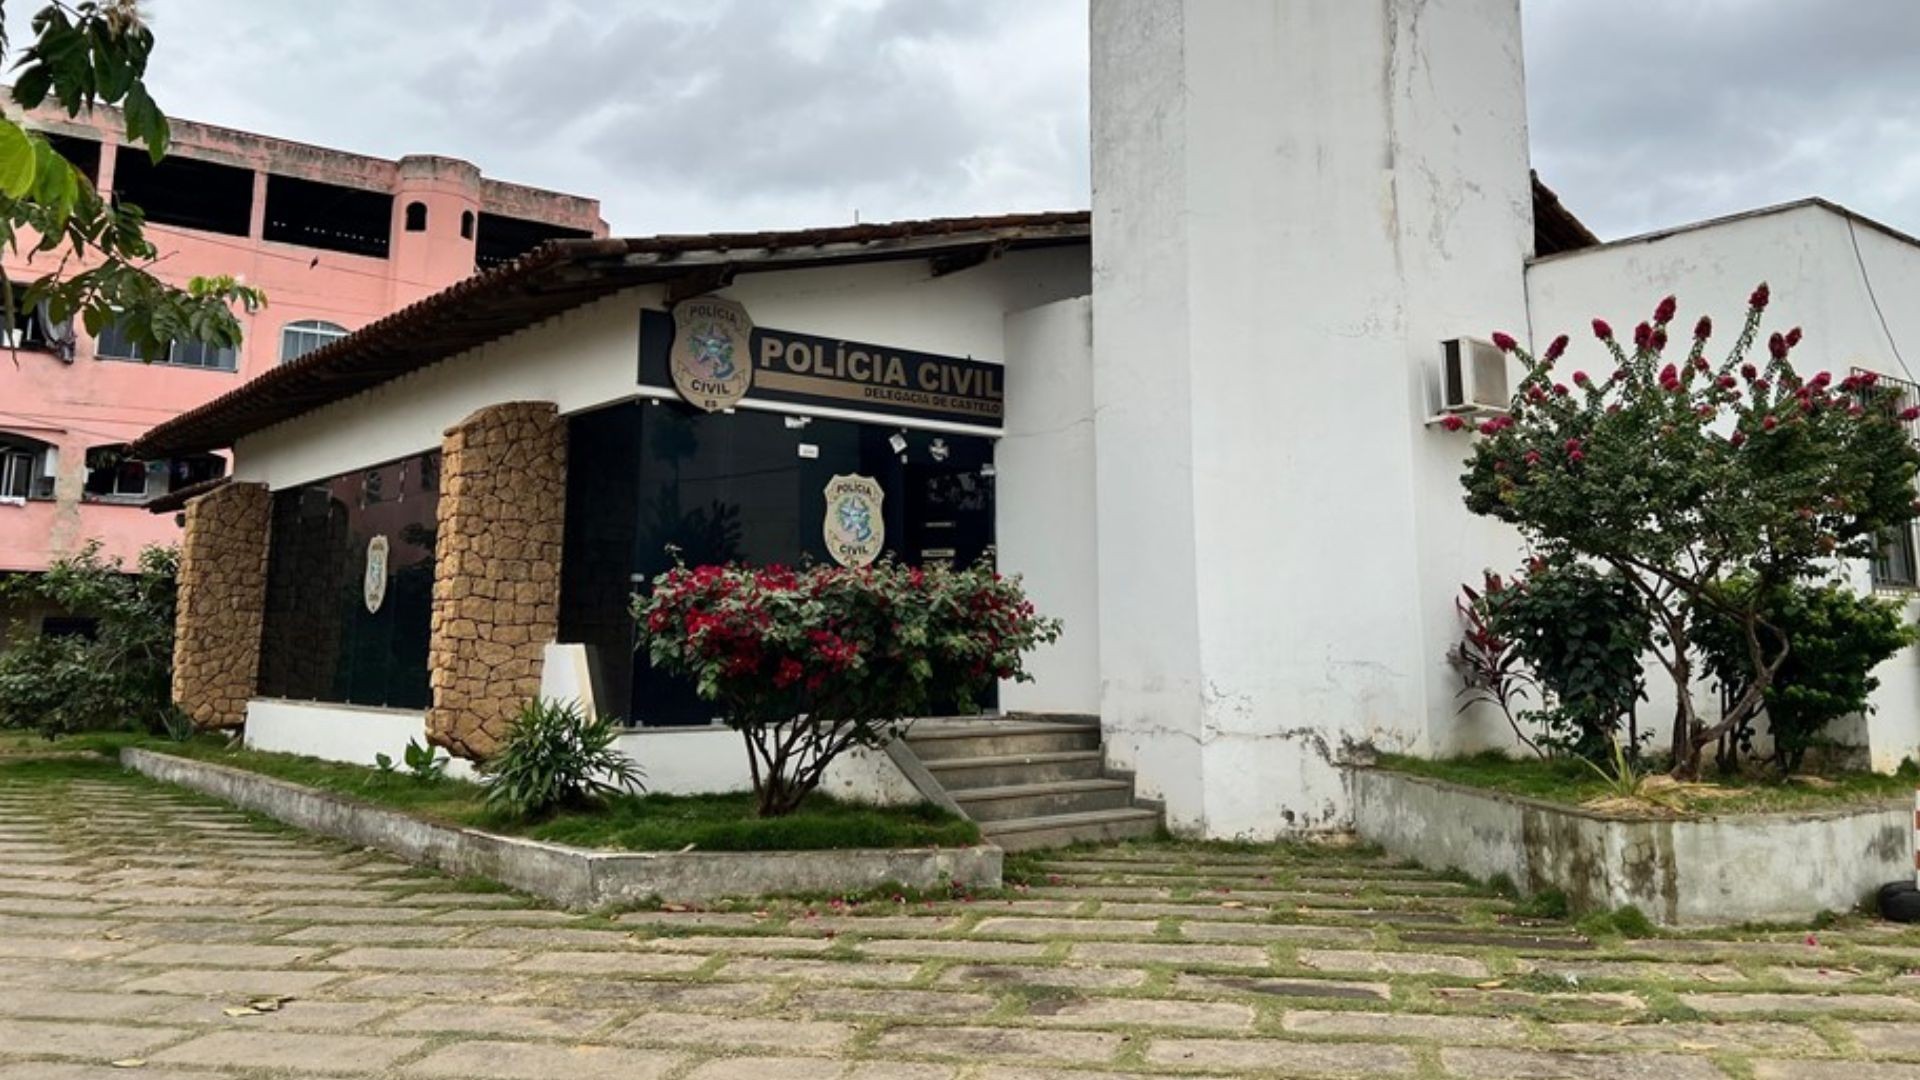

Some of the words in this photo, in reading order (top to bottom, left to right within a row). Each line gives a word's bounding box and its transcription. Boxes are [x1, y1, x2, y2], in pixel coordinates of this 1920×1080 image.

[690, 305, 735, 321] POLÍCIA
[761, 337, 906, 386] POLÍCIA
[918, 361, 1003, 398] CIVIL
[692, 379, 730, 394] CIVIL
[864, 387, 929, 405] DELEGACIA
[932, 395, 946, 407] DE
[951, 398, 1000, 413] CASTELO
[839, 544, 869, 555] CIVIL
